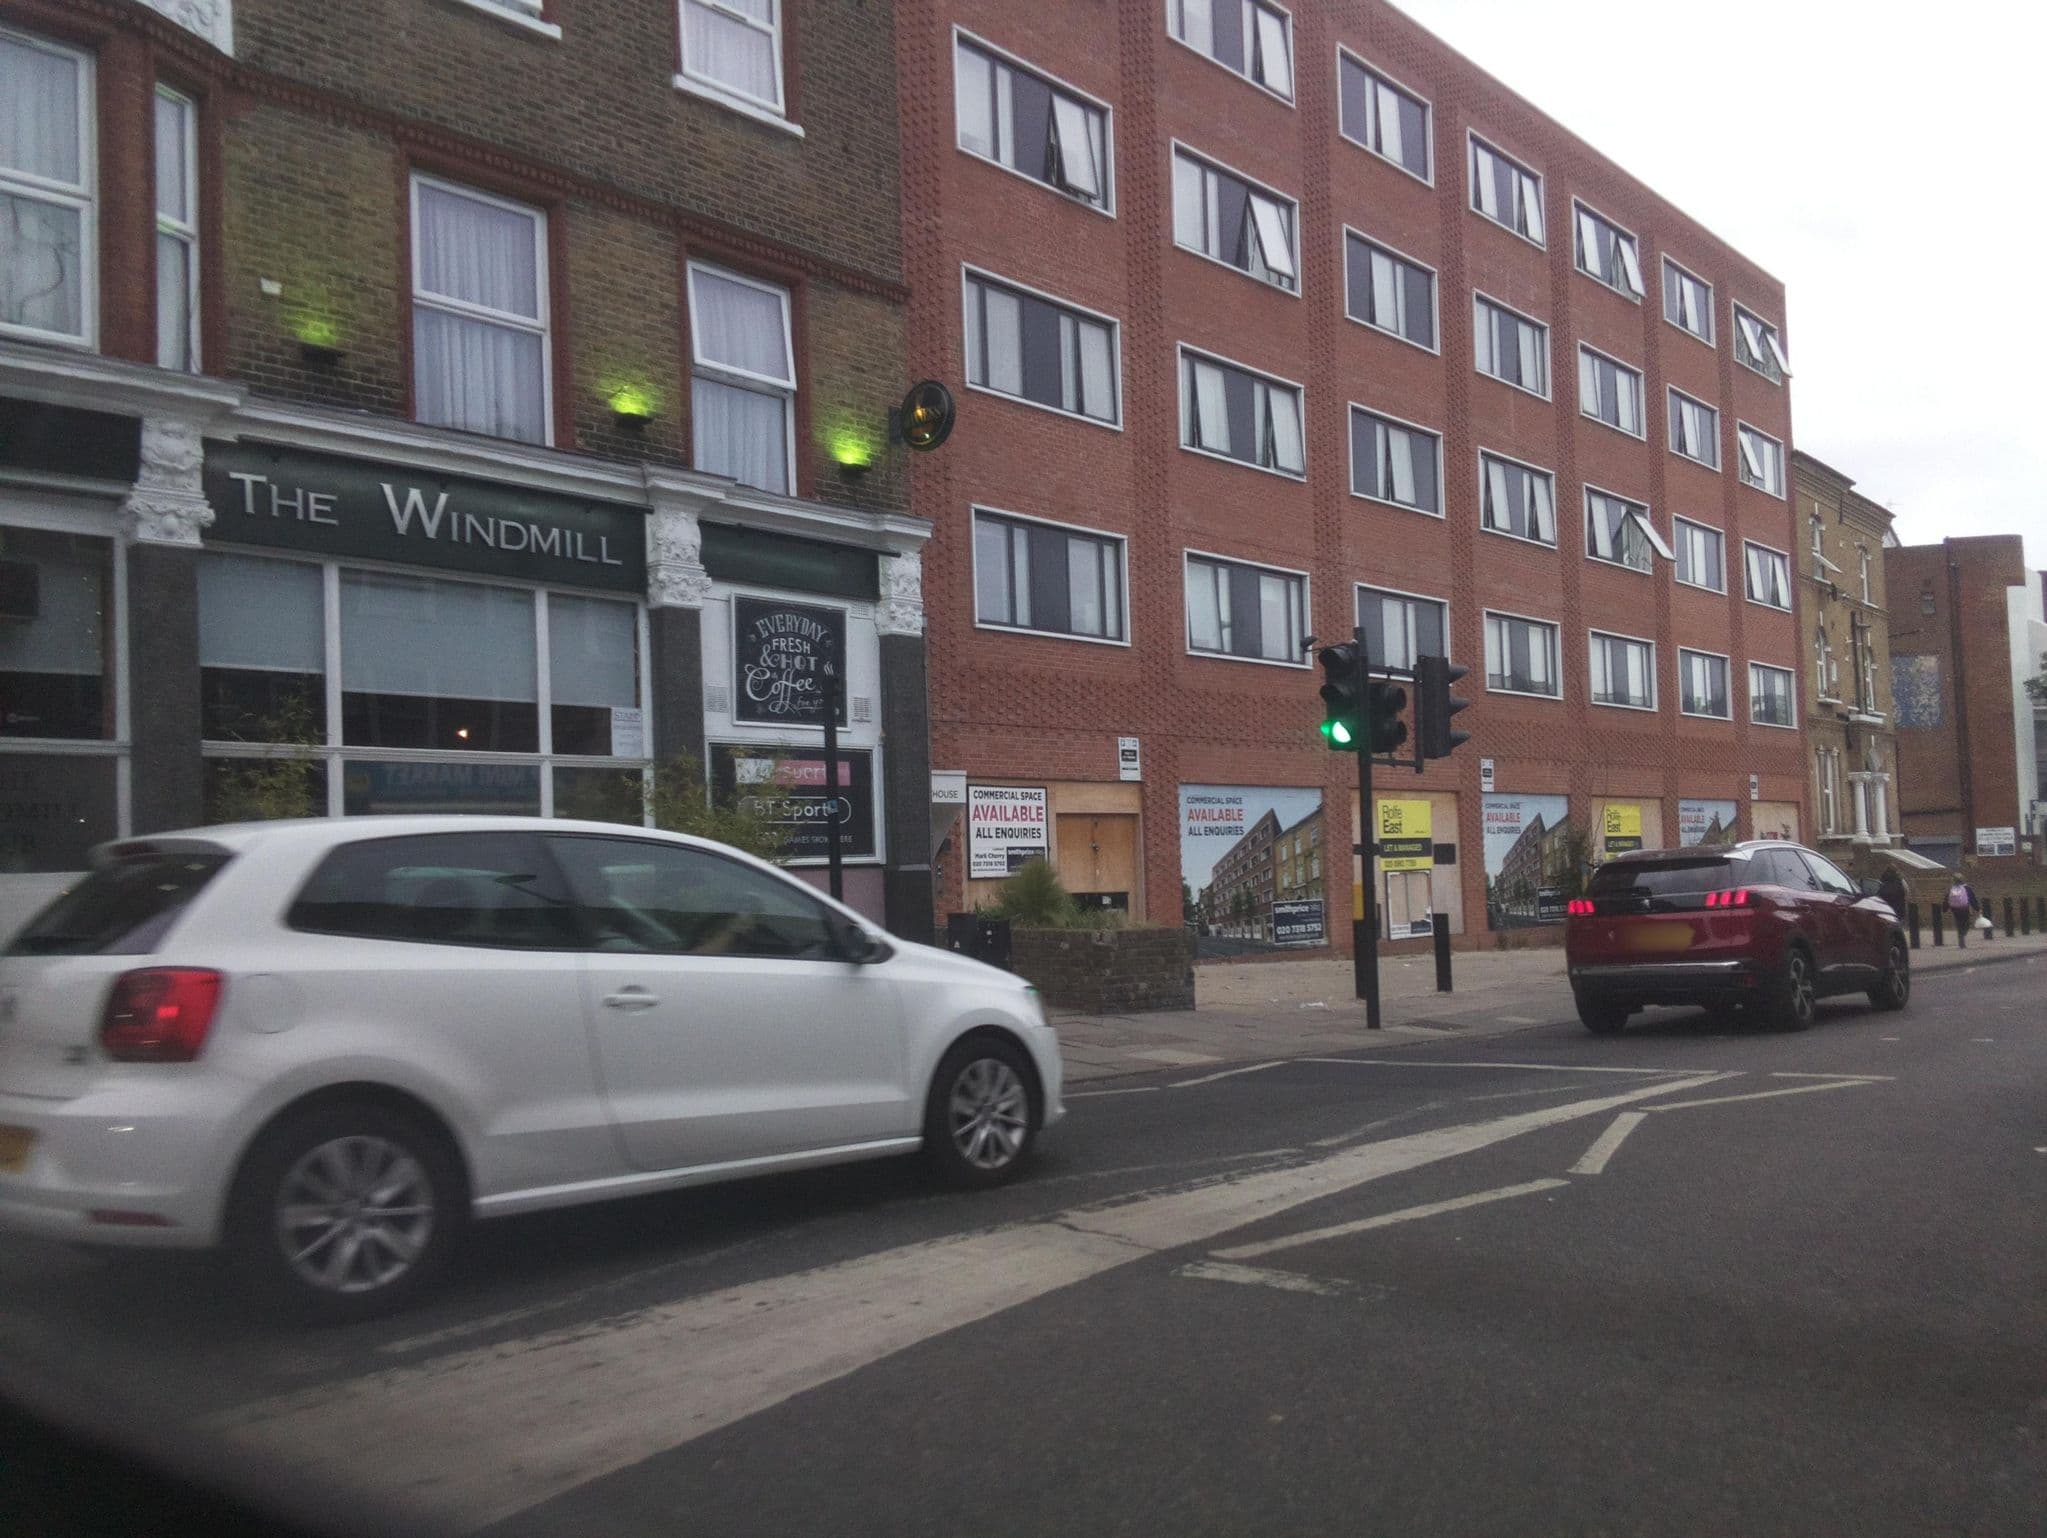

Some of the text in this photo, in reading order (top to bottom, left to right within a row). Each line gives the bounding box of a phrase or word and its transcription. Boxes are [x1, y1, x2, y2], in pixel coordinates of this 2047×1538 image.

[229, 471, 623, 566] THE WINDMILL
[755, 613, 830, 643] EVERYDAY
[772, 637, 811, 654] FRESH
[780, 656, 818, 671] HOT
[744, 663, 817, 714] Coffee
[932, 790, 959, 799] HOUSE
[973, 790, 1042, 801] COMMERCIAL SPACE
[783, 800, 829, 821] Sport
[972, 804, 1044, 822] AVAILABLE
[1188, 808, 1243, 822] AVAILABLE
[975, 827, 1042, 839] ALL ENQUIRIES
[1188, 825, 1244, 836] ALL ENQUIRIES
[1383, 819, 1403, 834] East
